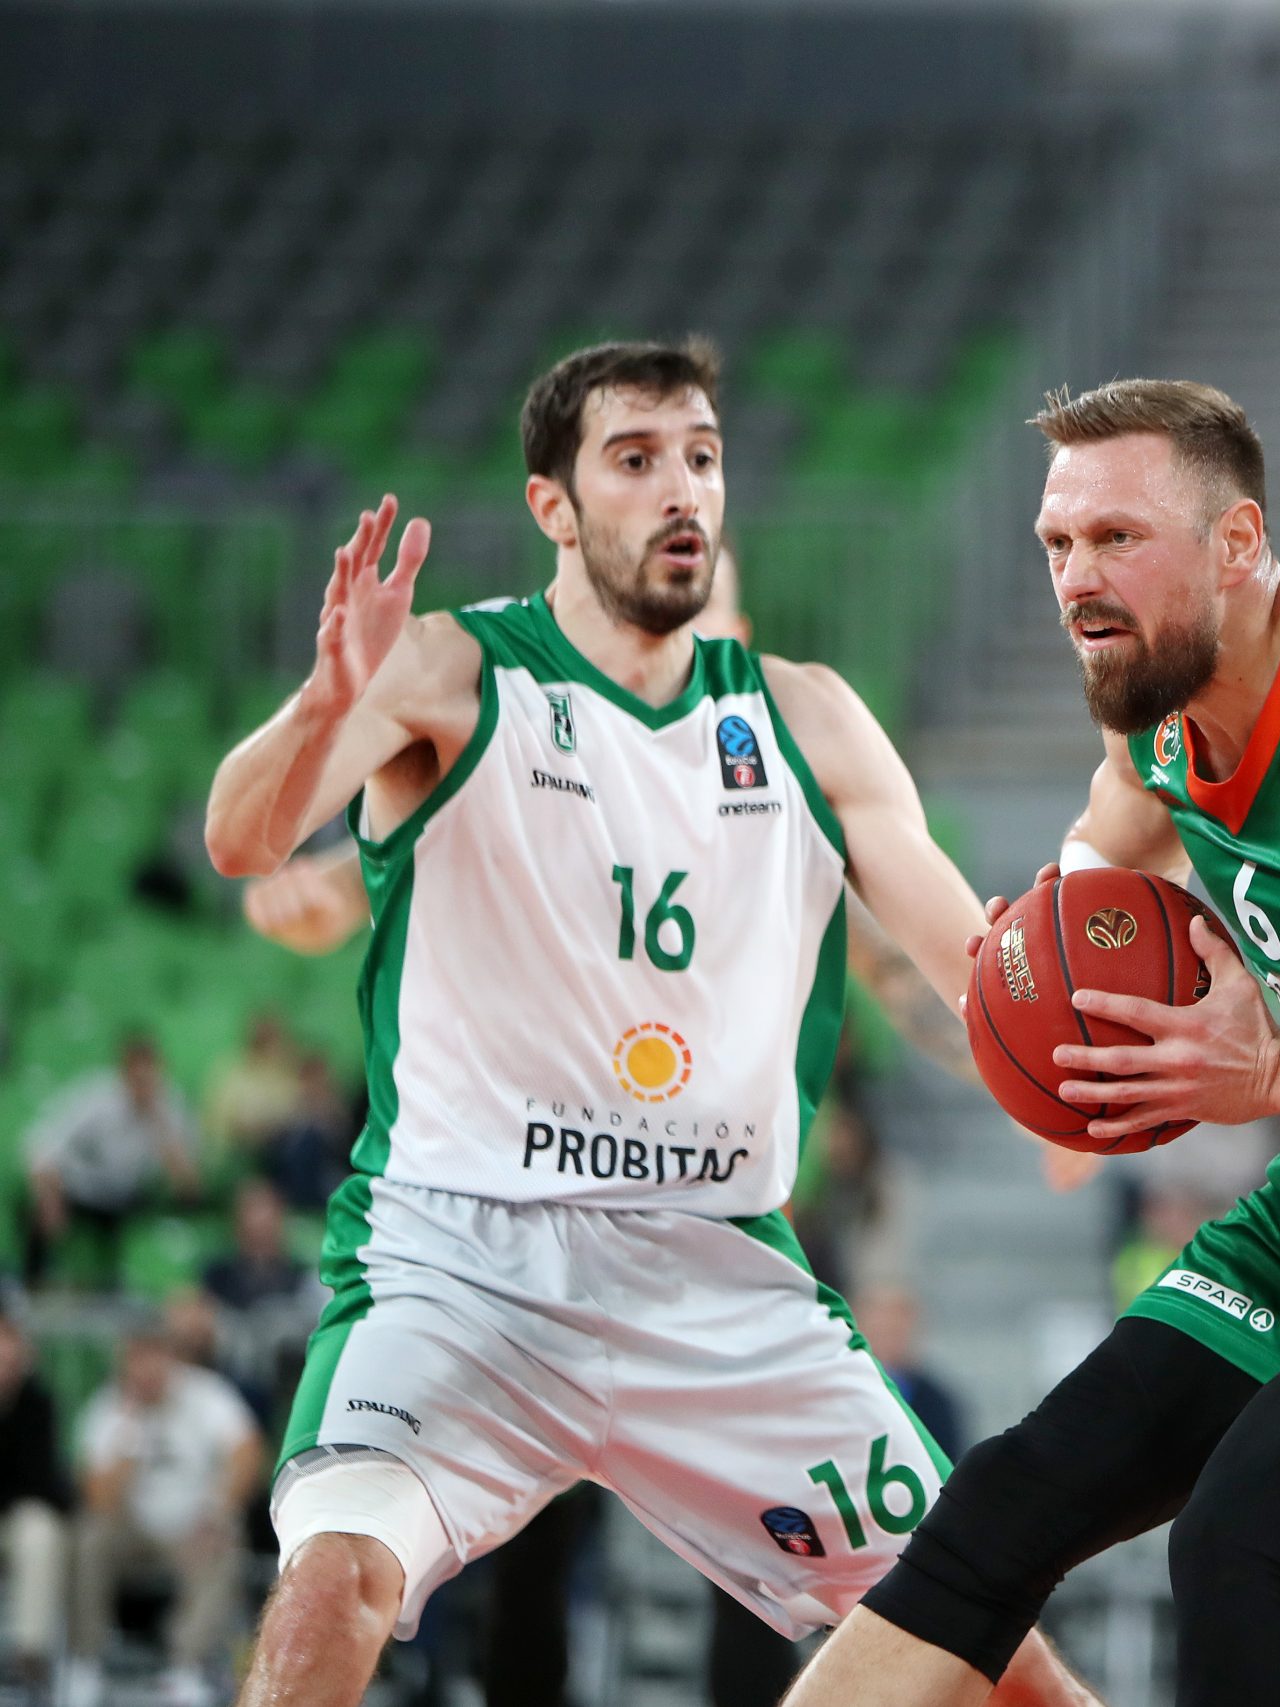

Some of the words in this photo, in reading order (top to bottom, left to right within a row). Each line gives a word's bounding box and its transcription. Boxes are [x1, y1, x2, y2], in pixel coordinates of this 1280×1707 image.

[718, 802, 781, 816] oneteam
[612, 864, 695, 971] 16
[526, 1098, 756, 1140] FUNDACIÓN
[1176, 1274, 1248, 1315] SPAR
[346, 1399, 421, 1436] SPALDING
[806, 1434, 927, 1551] 16
